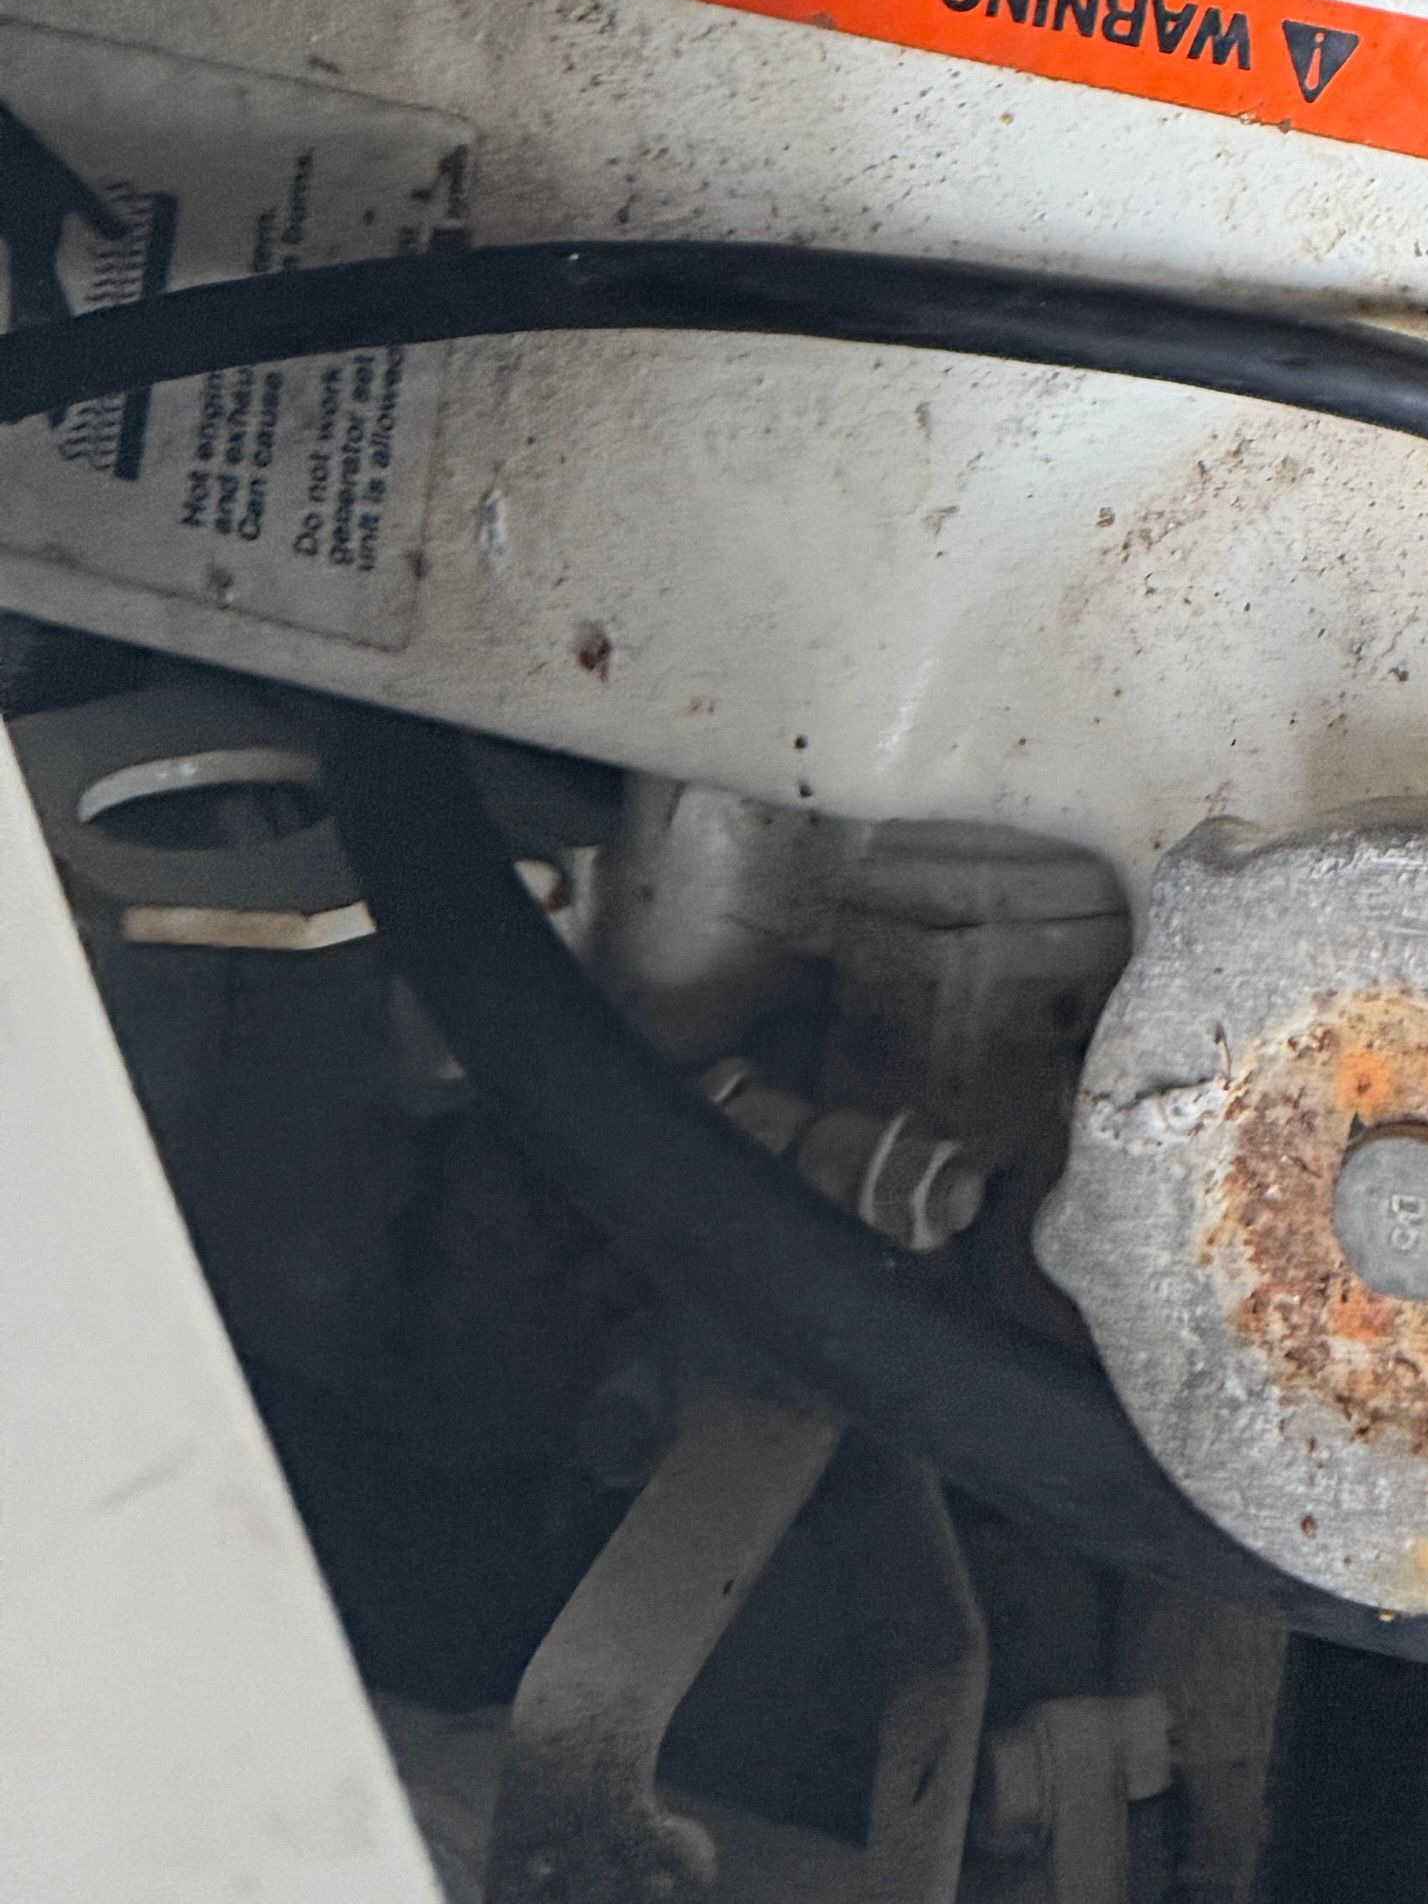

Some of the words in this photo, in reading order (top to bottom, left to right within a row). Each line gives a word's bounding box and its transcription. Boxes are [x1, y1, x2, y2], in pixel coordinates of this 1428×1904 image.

[197, 371, 222, 461] engin
[225, 368, 253, 466] exhau
[294, 513, 325, 557] Do
